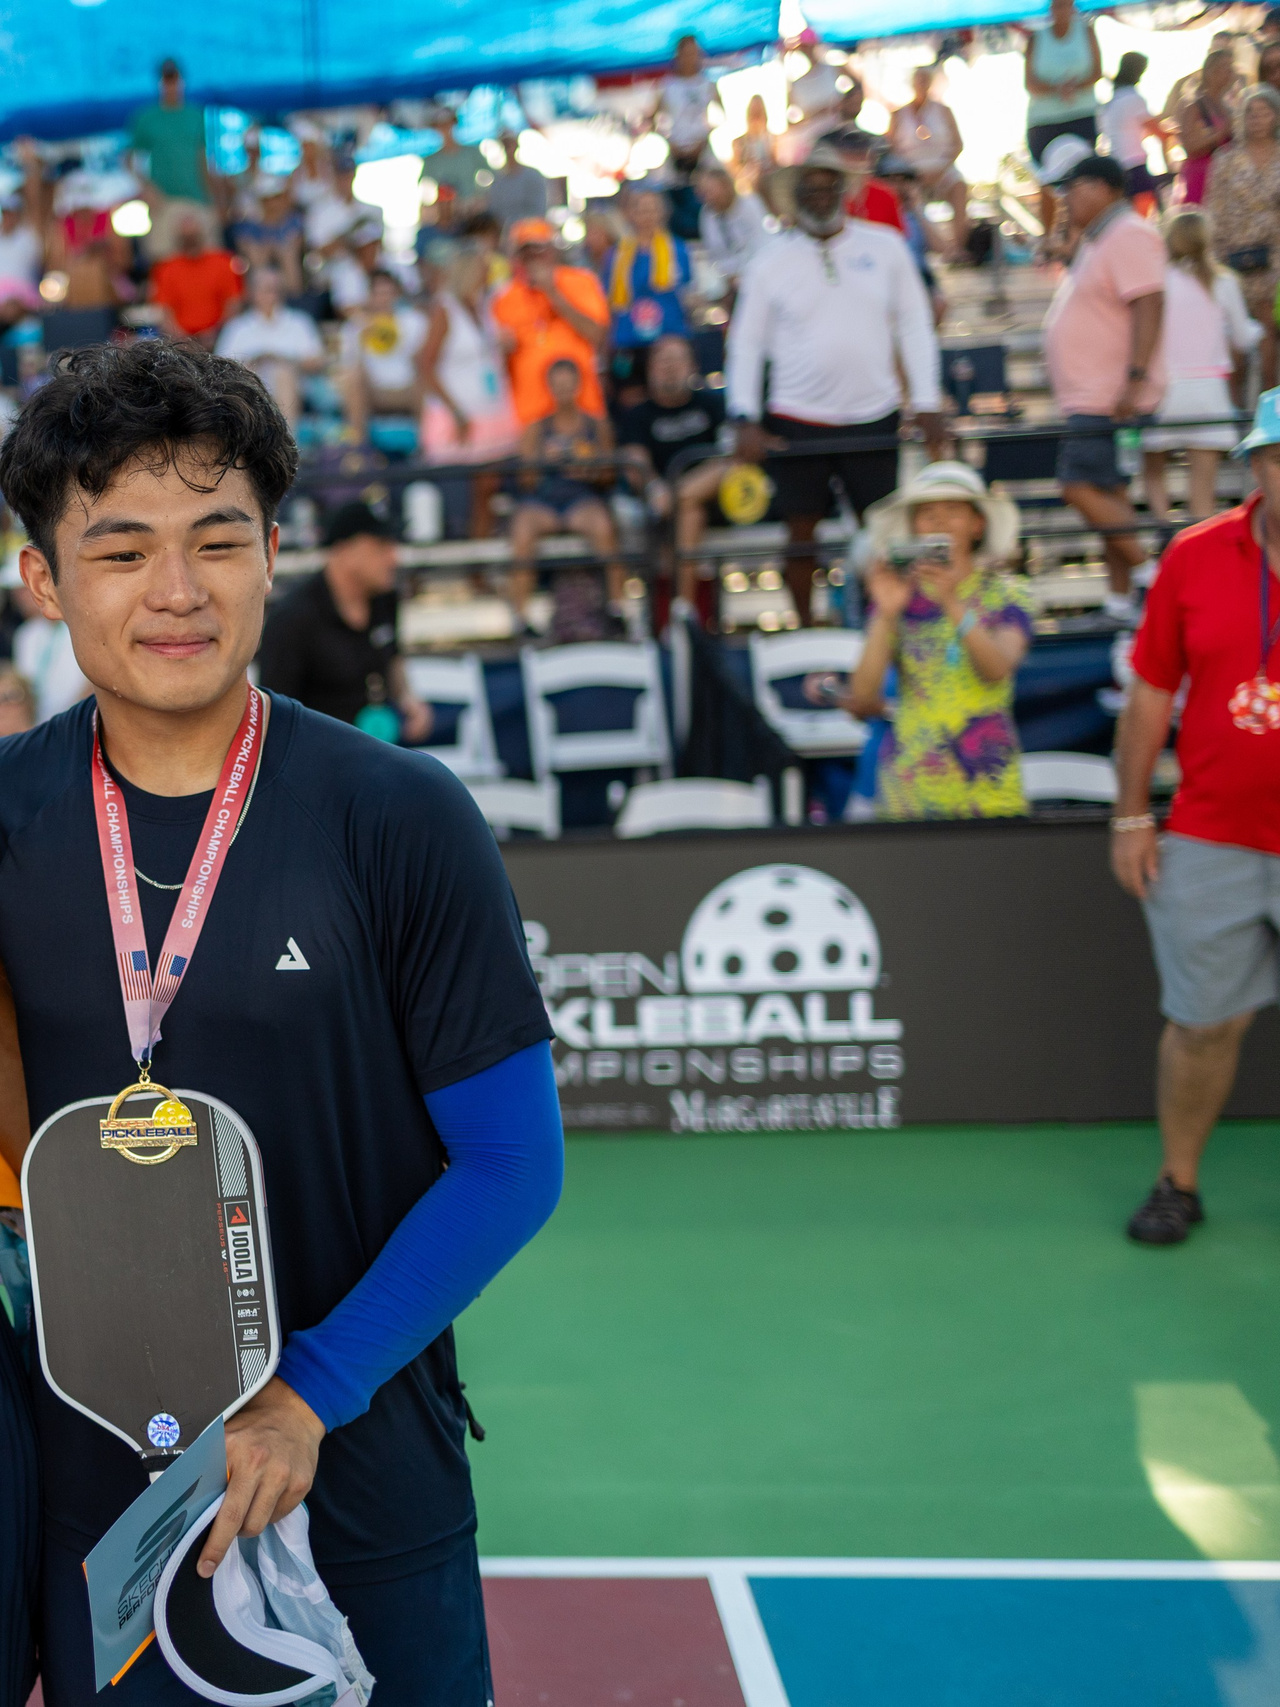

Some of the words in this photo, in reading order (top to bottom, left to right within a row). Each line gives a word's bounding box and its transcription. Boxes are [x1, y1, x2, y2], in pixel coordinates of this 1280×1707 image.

[248, 689, 258, 727] OPEN
[221, 726, 256, 806] PICKLEBALL
[106, 802, 134, 925] CHAMPIONSHIPS
[181, 808, 231, 930] CHAMPIONSHIPS
[543, 989, 904, 1050] KLEBALL
[554, 1044, 906, 1089] MPIONSHIPS
[101, 1127, 195, 1138] PICKLEBALL
[216, 1202, 226, 1247] PERSEUS
[231, 1230, 253, 1280] JOOLA
[117, 1542, 179, 1620] SKECH
